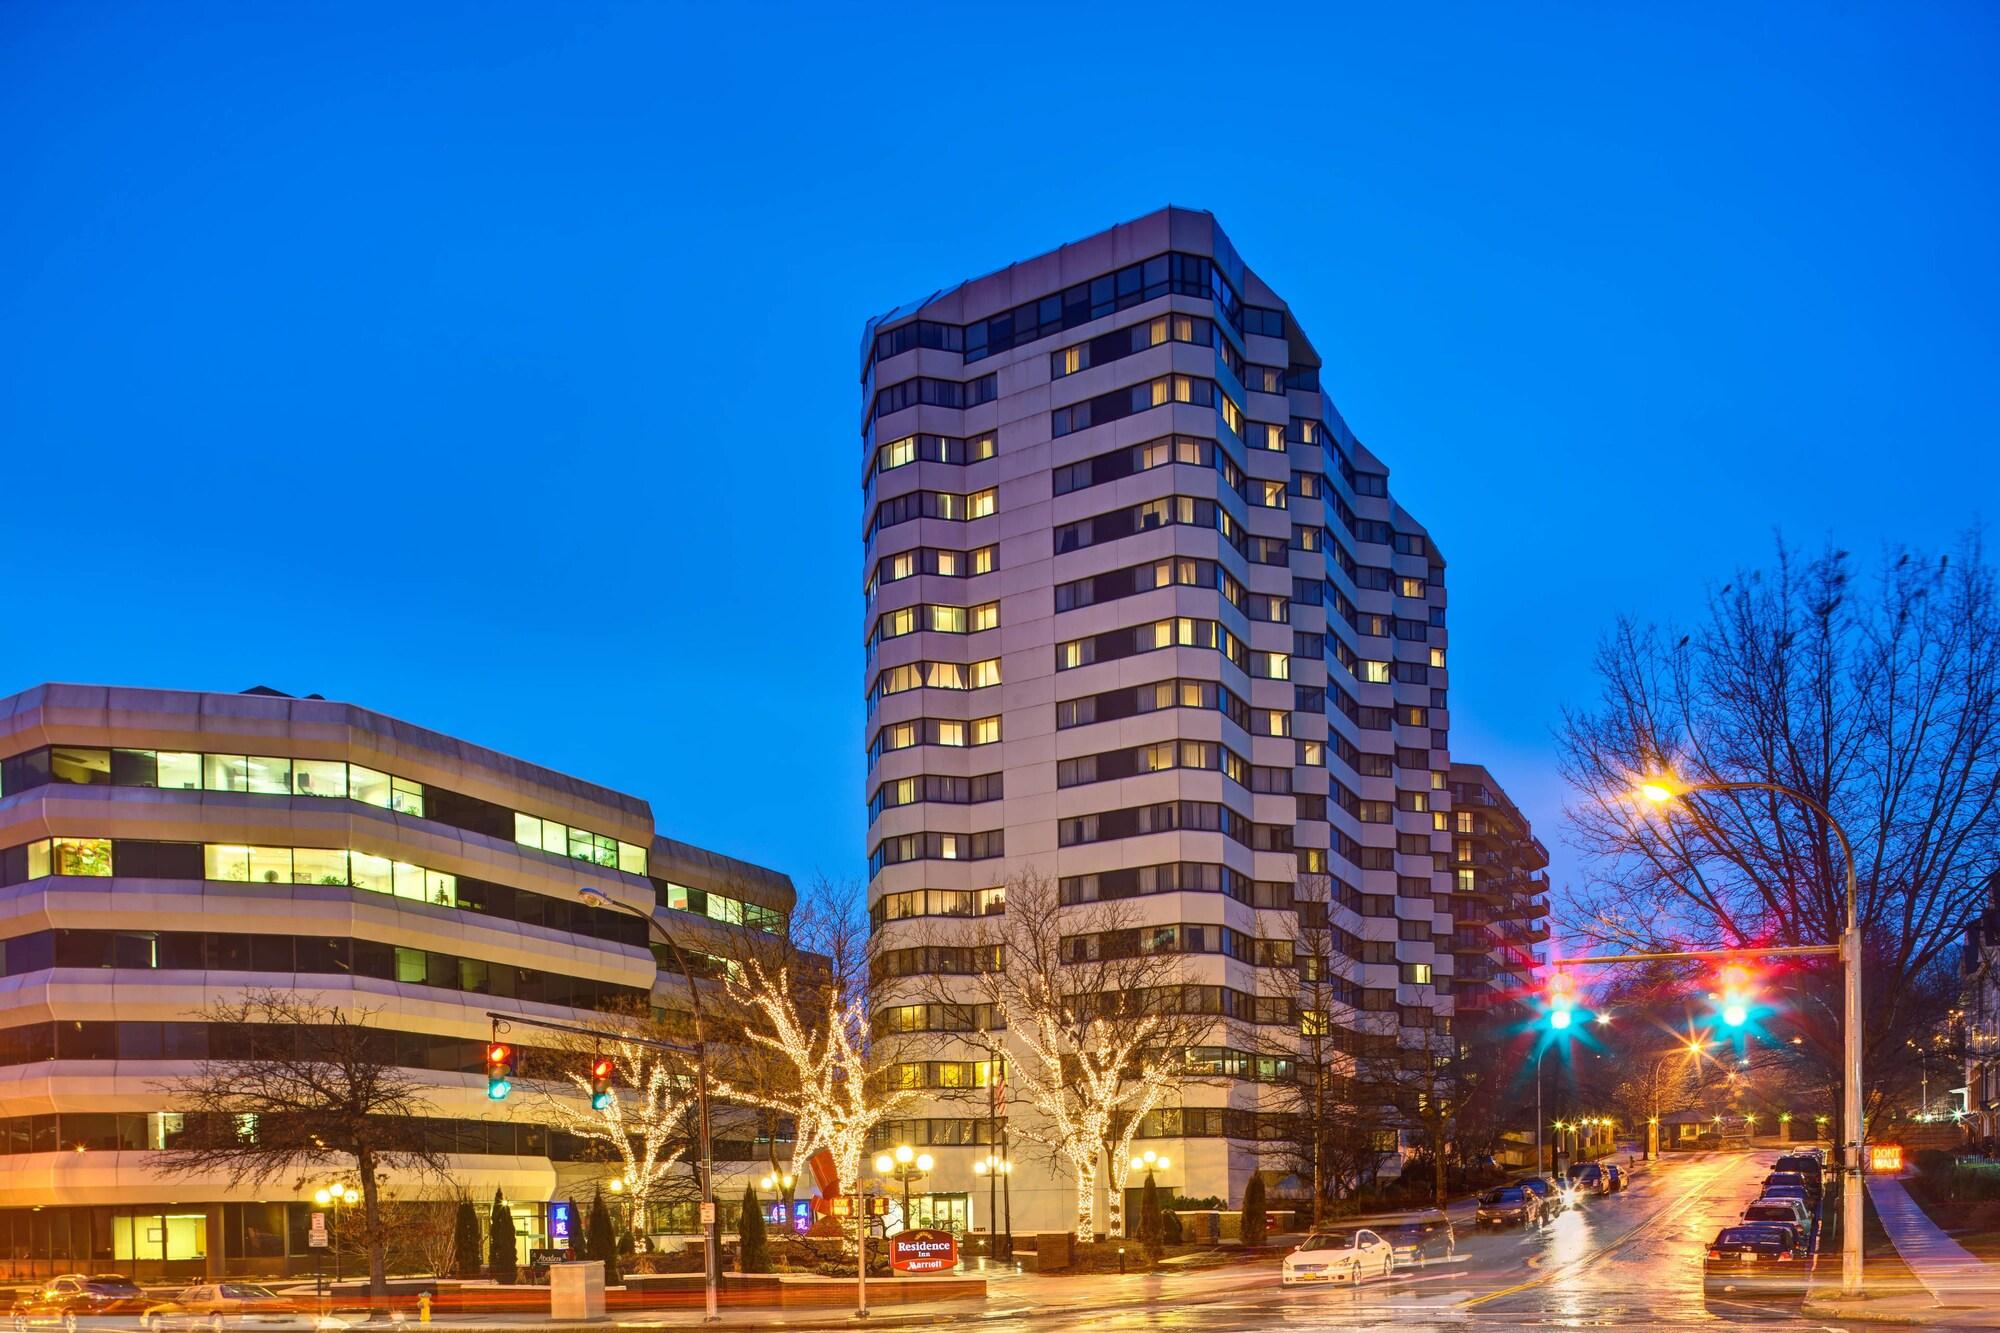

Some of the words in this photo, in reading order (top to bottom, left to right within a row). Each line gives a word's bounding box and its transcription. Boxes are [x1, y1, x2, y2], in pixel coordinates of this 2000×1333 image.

[1874, 1148, 1900, 1158] DONT
[1874, 1158, 1900, 1169] WALK
[898, 1241, 950, 1252] Residence
[907, 1260, 942, 1270] Marriott
